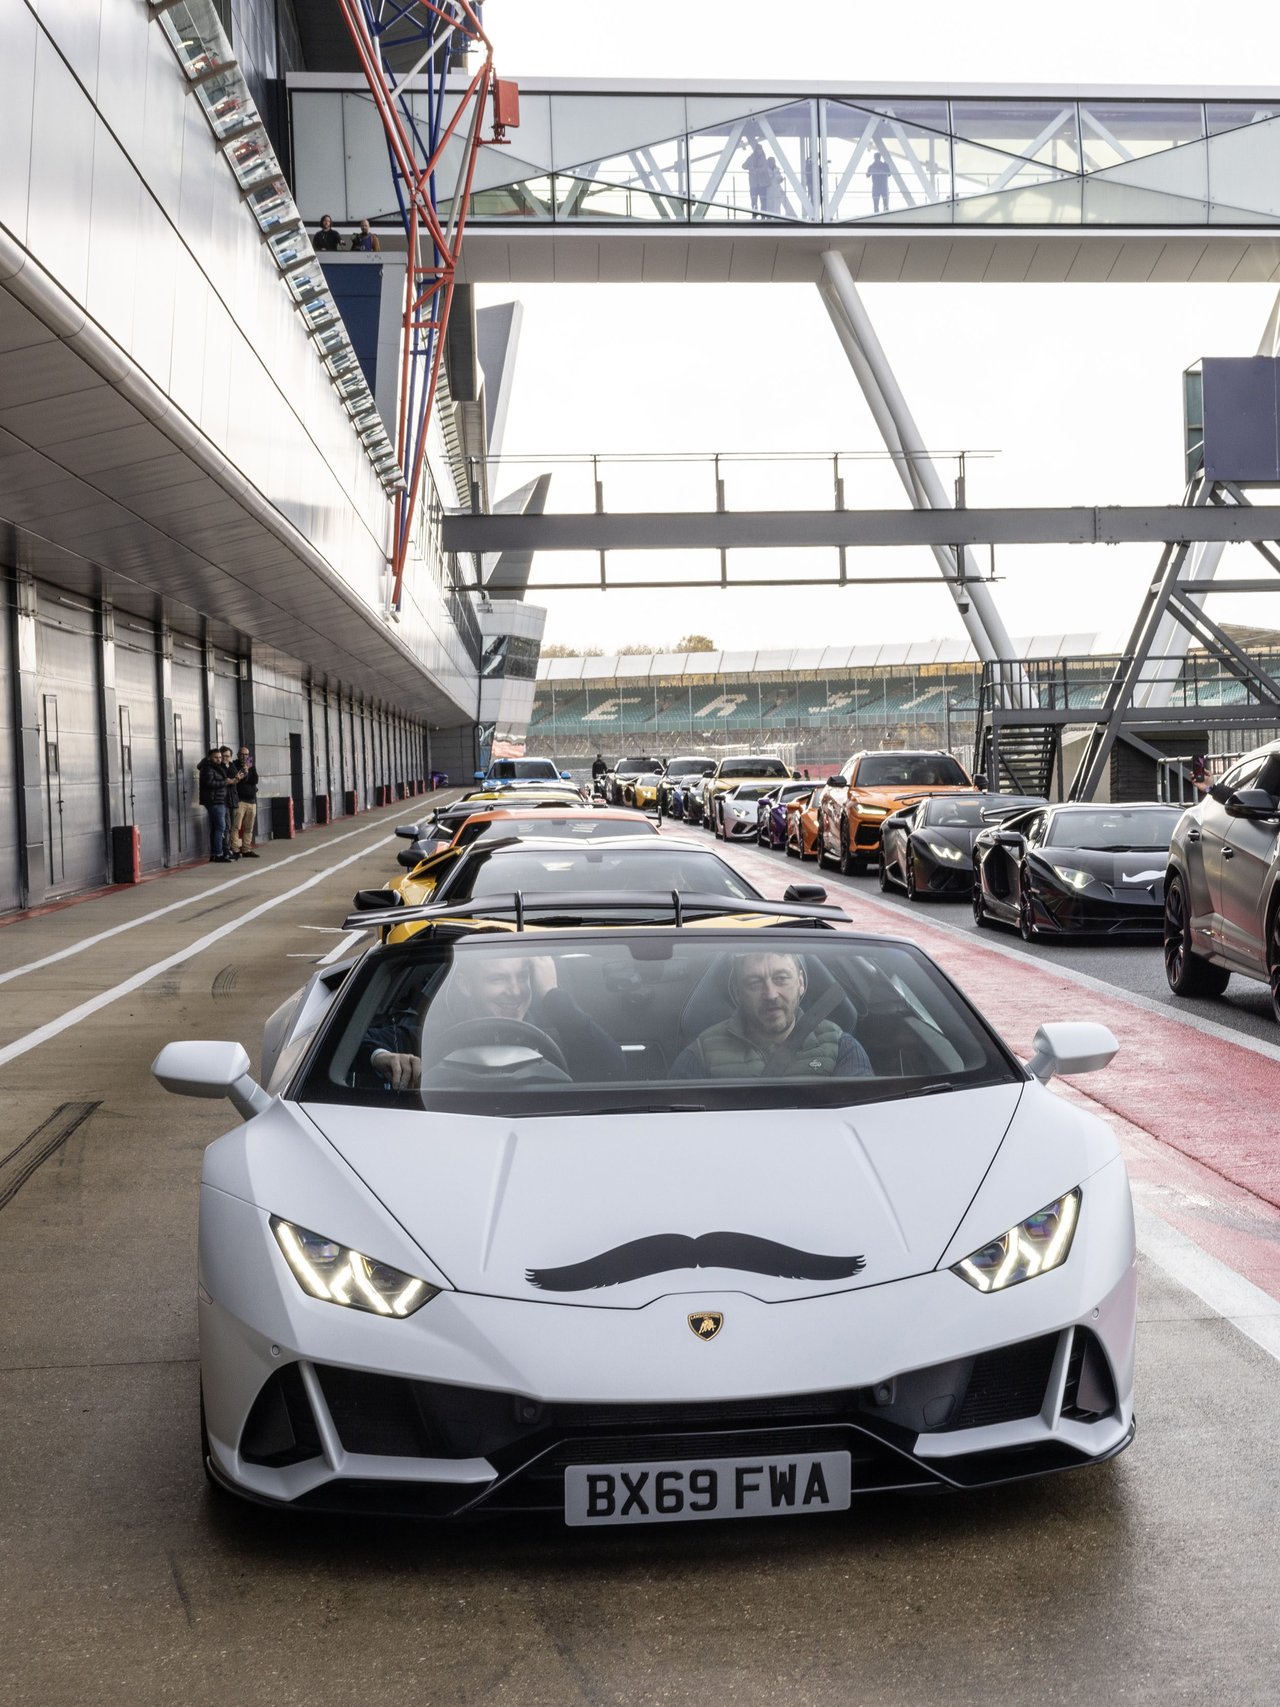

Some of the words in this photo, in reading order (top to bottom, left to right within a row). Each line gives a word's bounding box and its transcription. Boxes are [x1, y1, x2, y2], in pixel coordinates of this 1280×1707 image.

[533, 685, 957, 721] ERST
[586, 1469, 718, 1518] BX69
[735, 1461, 830, 1510] FWA
